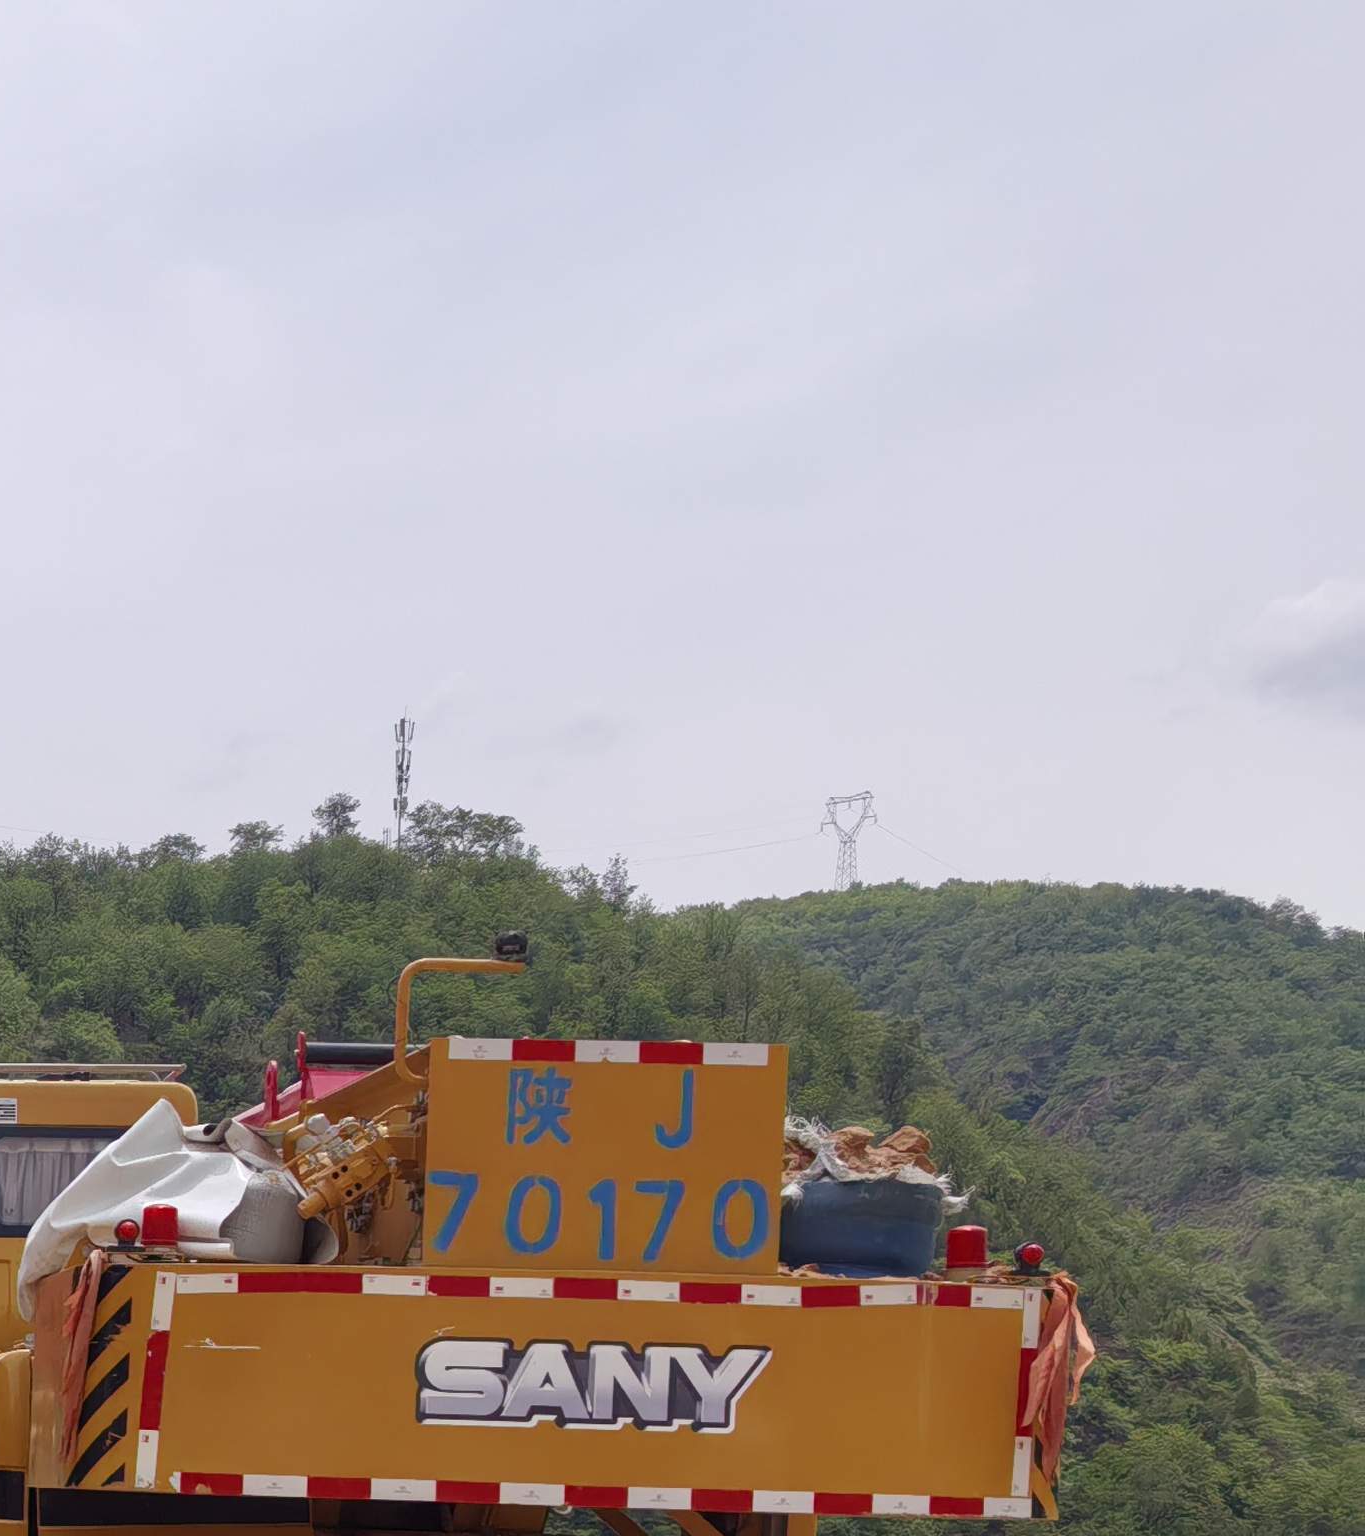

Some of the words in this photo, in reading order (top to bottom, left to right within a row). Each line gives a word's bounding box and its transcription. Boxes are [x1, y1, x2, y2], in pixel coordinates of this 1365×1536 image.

[505, 1067, 572, 1146] 陕
[654, 1068, 695, 1150] J
[427, 1169, 771, 1262] 70170
[420, 1338, 772, 1432] SANY
